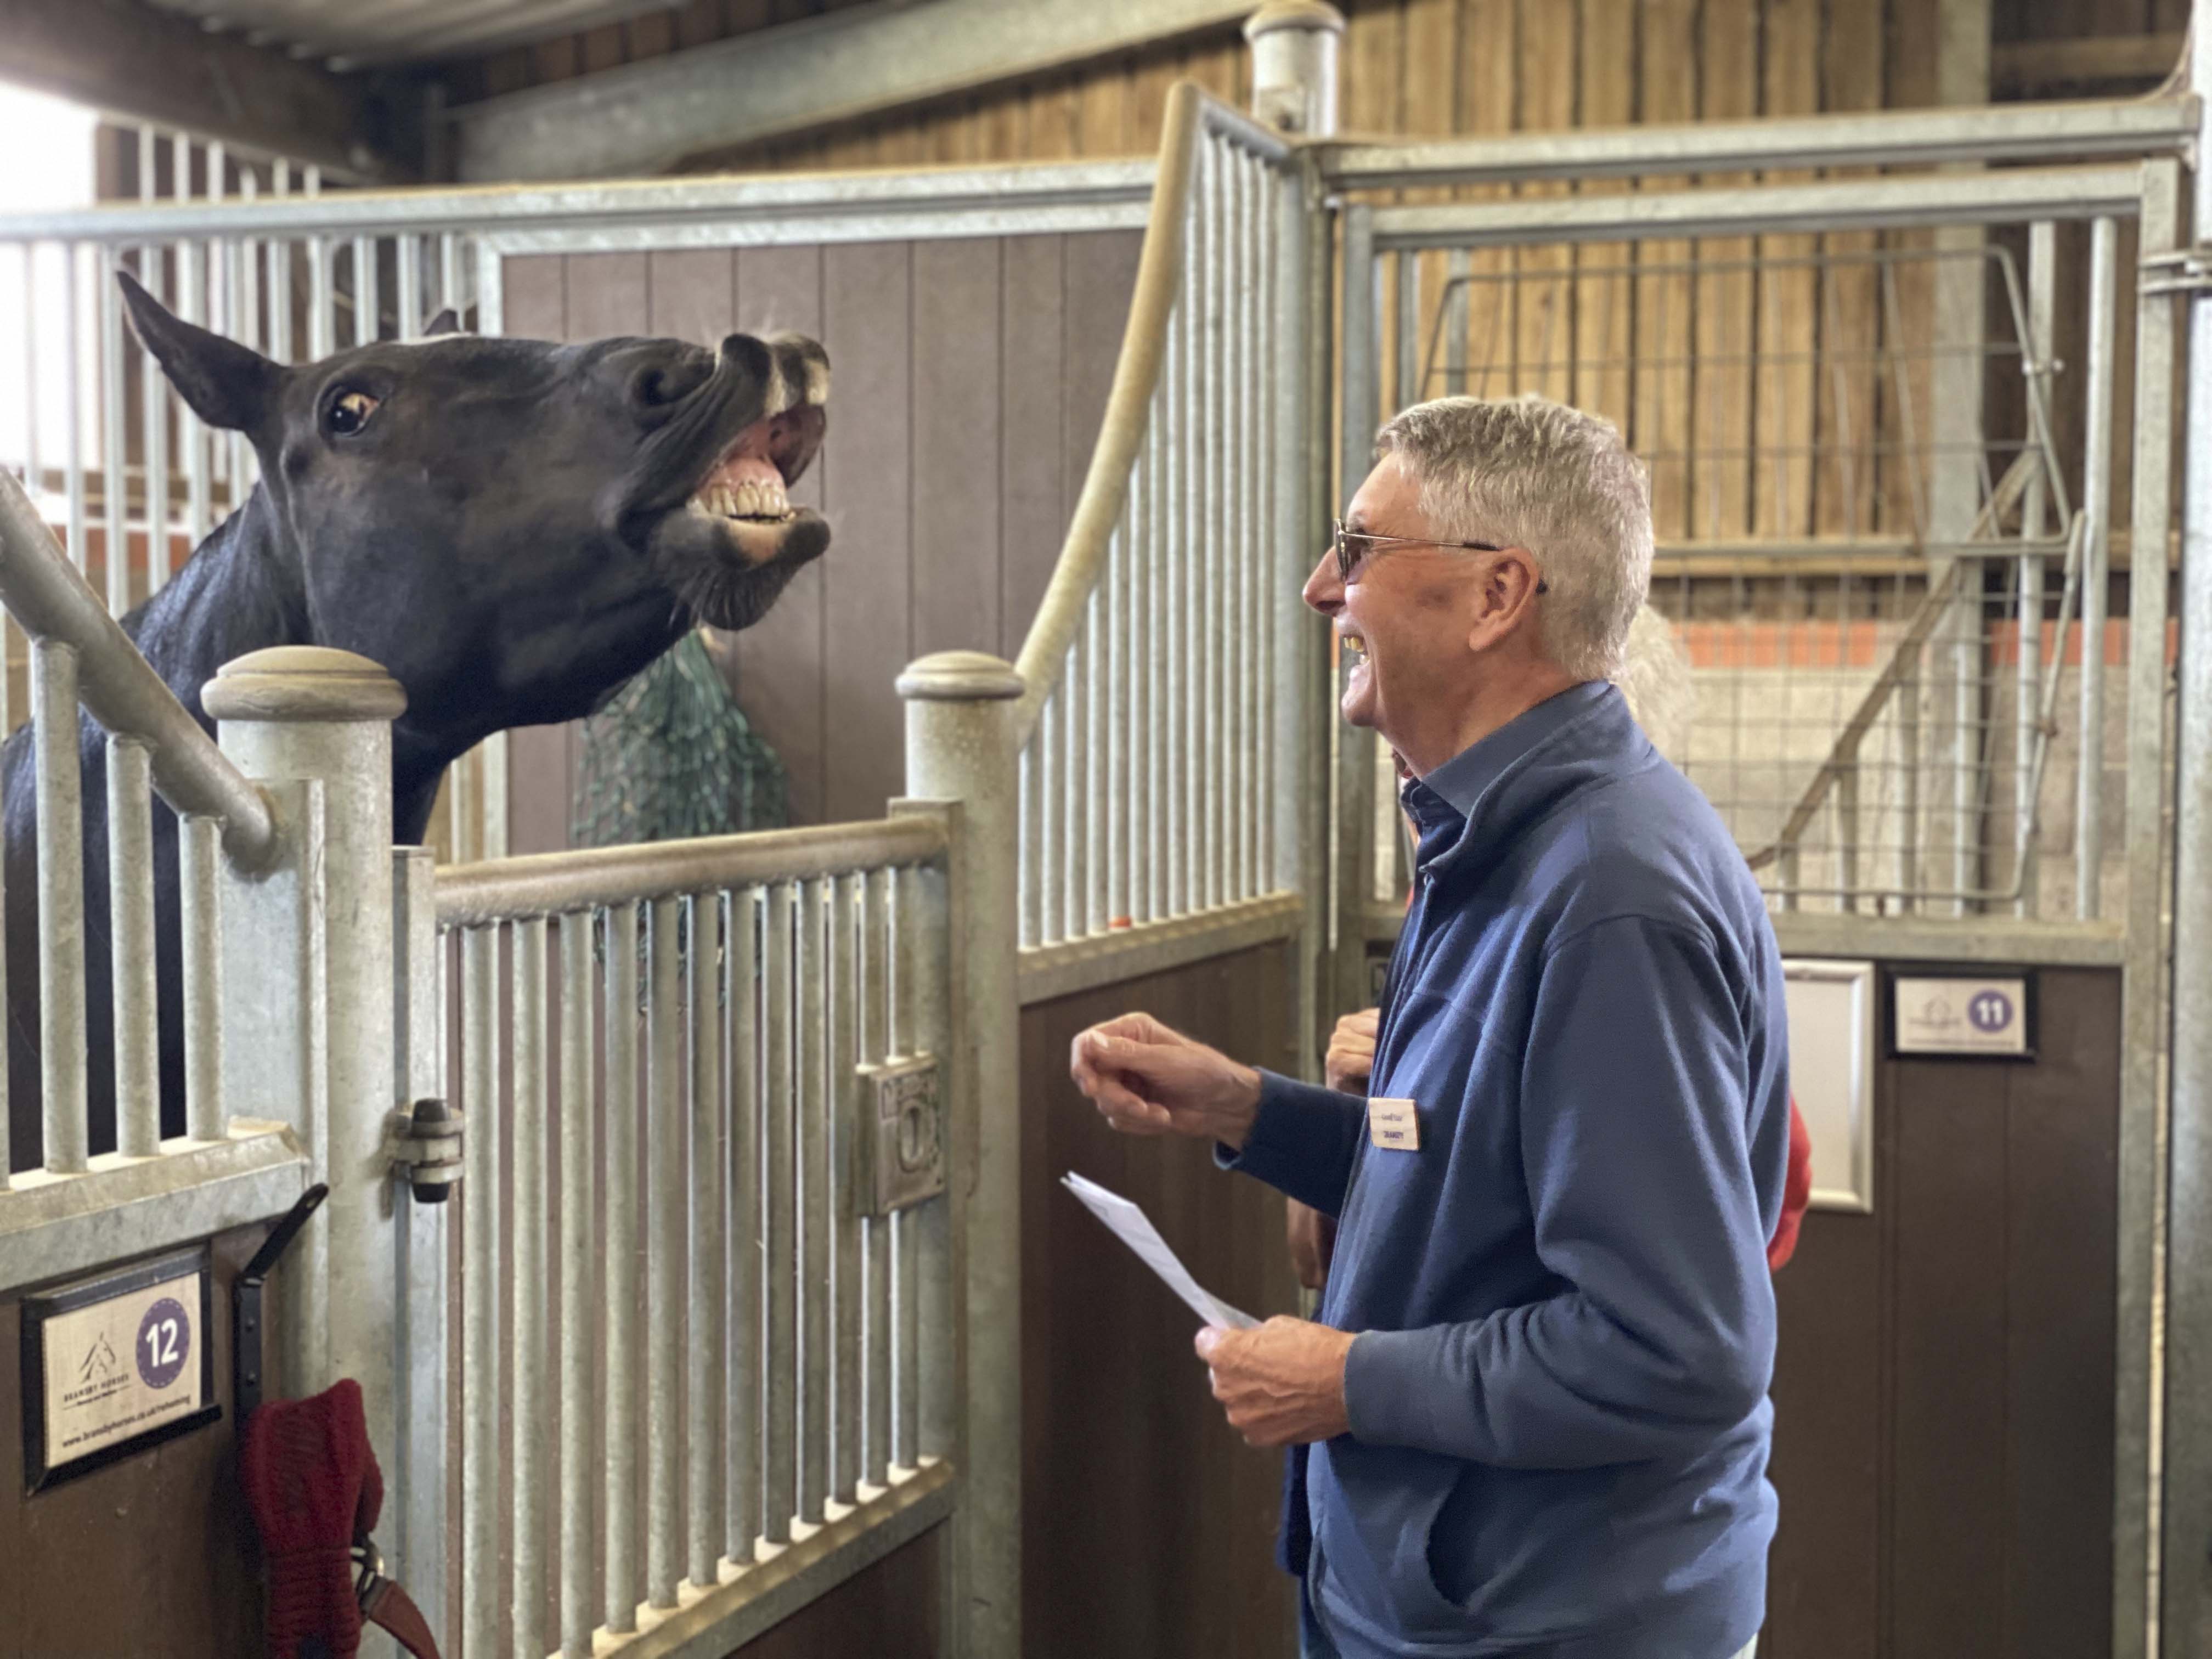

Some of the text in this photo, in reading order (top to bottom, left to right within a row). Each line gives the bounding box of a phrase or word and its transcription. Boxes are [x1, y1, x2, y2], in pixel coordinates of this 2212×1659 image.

[1977, 999, 2004, 1025] 11
[146, 1318, 179, 1367] 12
[64, 1383, 97, 1402] BRANSBY
[101, 1374, 128, 1389] HORSES
